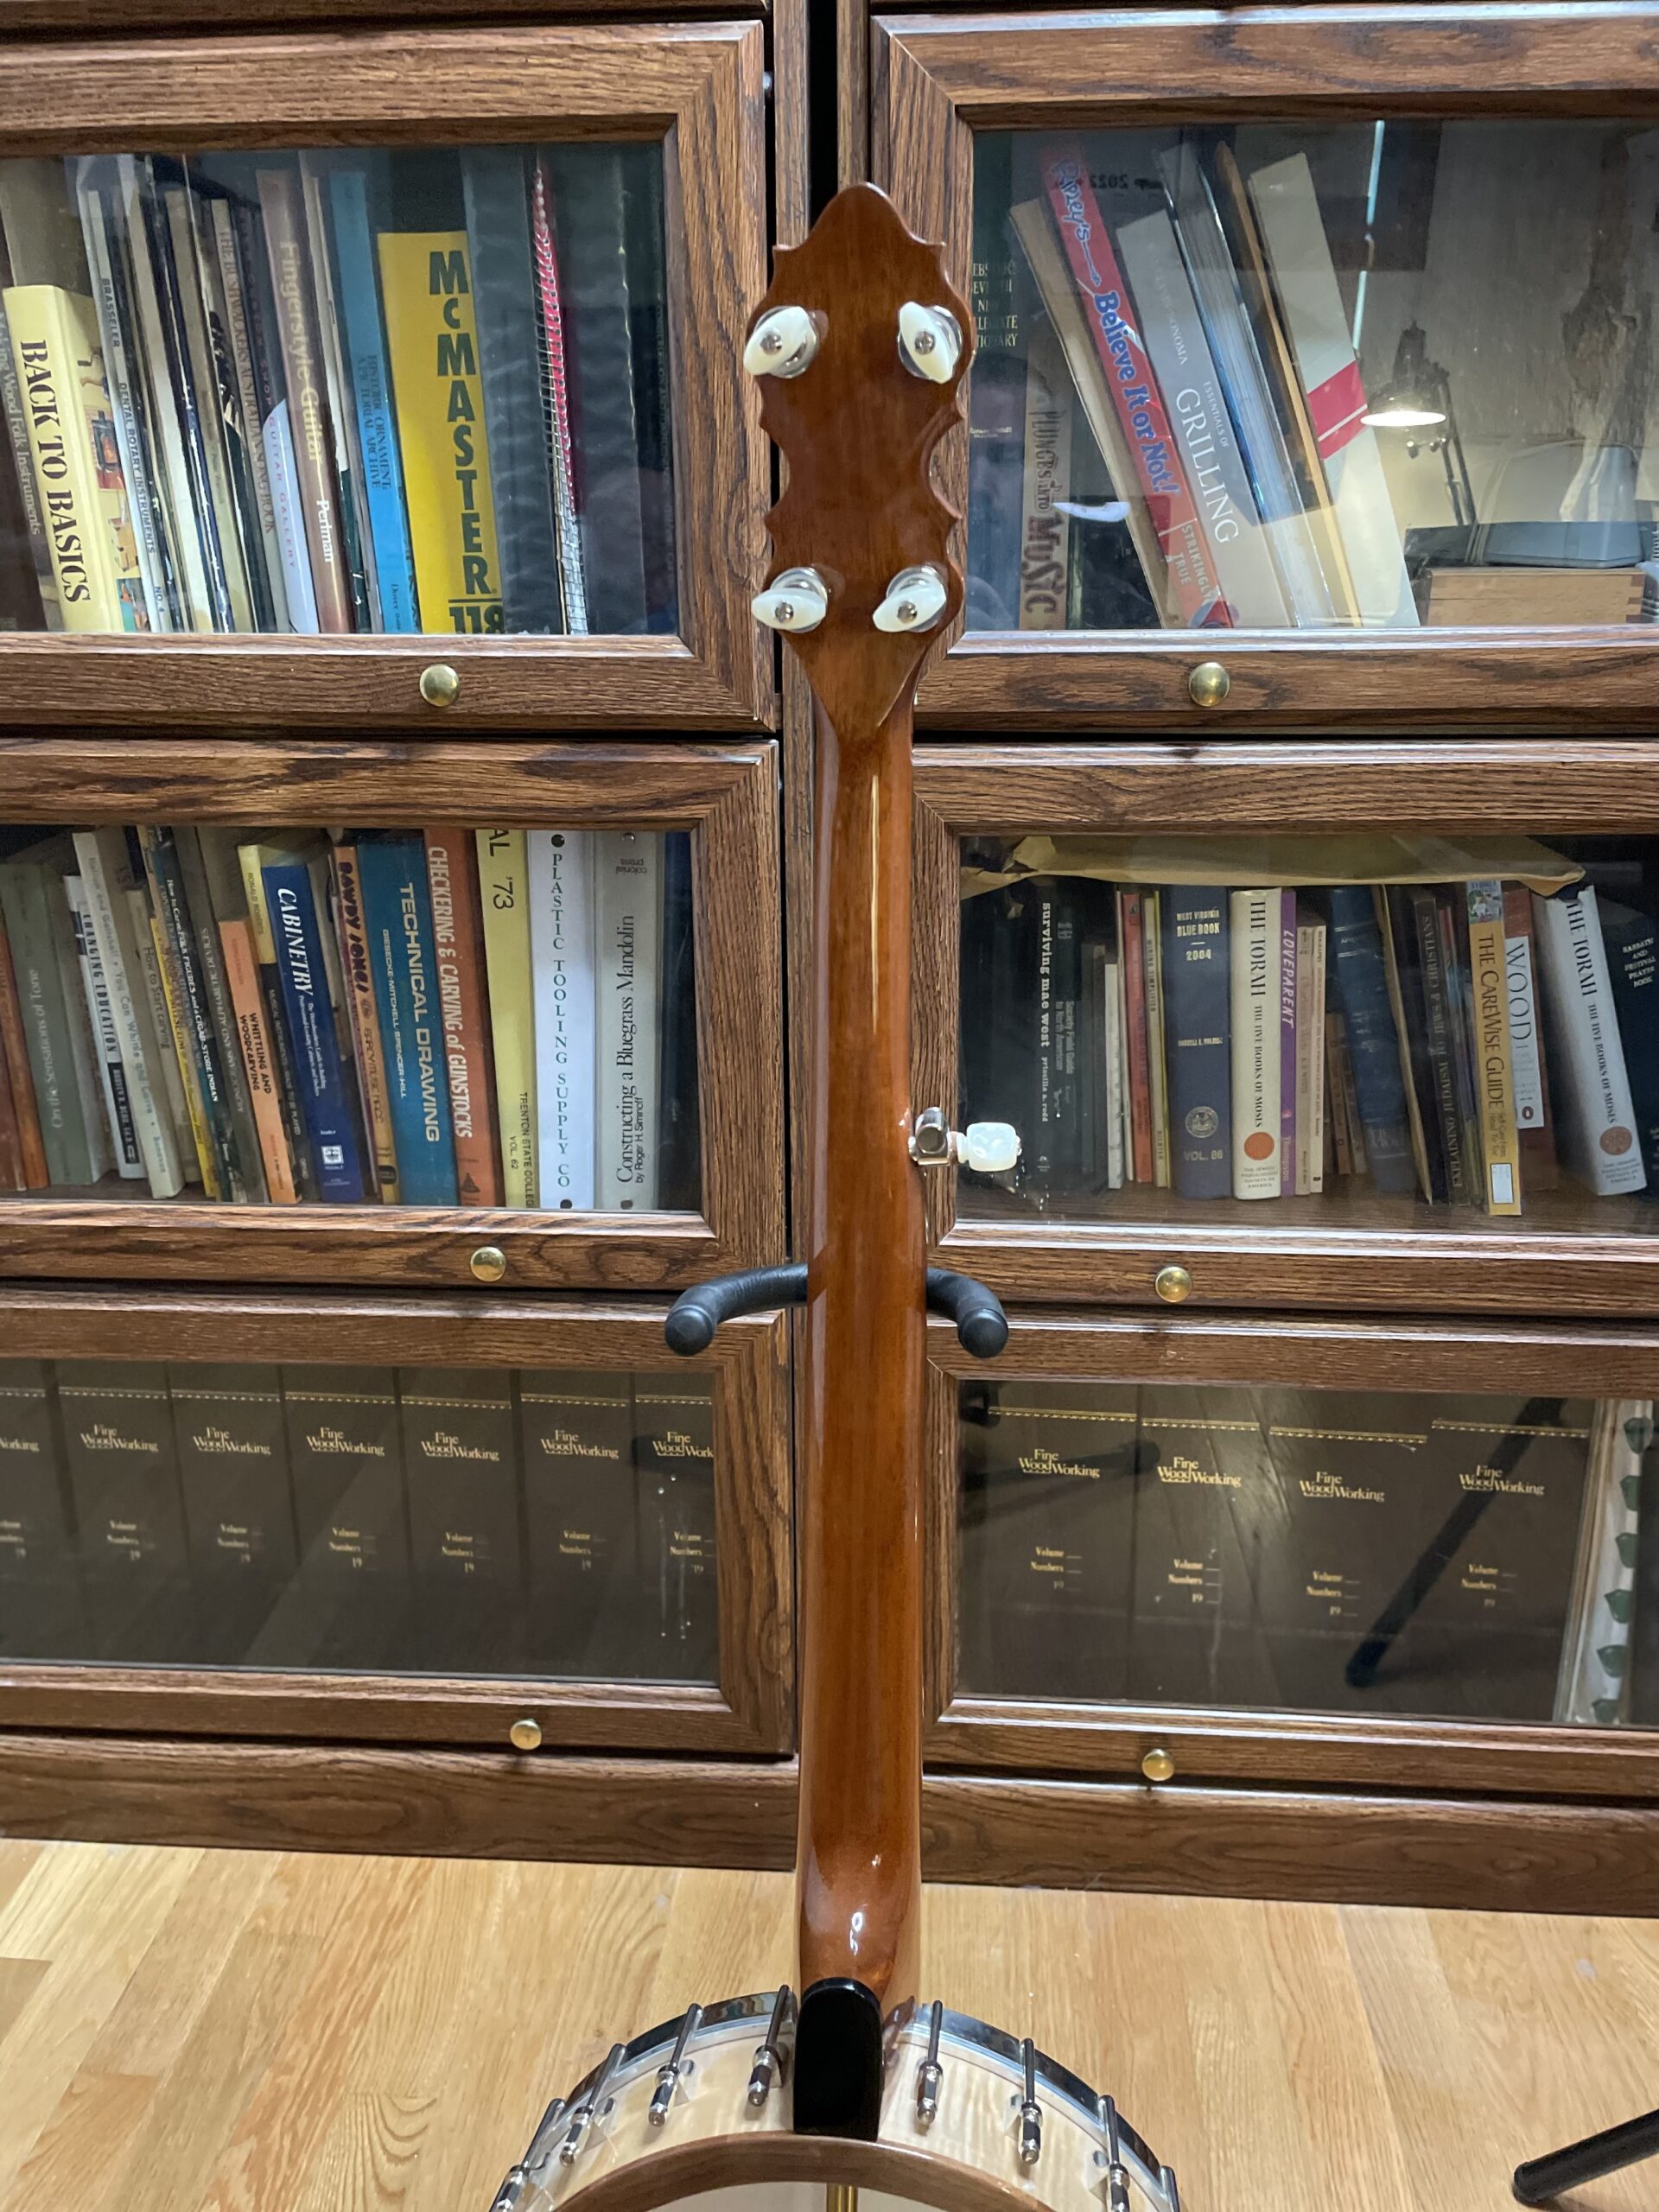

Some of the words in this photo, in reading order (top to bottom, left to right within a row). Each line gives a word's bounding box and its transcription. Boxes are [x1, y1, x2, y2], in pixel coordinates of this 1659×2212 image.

[101, 277, 120, 347] BRASSELER
[276, 238, 316, 381] Fingerstyle
[299, 385, 327, 464] Guitar
[1094, 290, 1136, 381] Believe
[5, 372, 22, 416] Wood
[20, 339, 61, 429] BACK
[1123, 385, 1151, 410] It
[1133, 411, 1155, 440] or
[1204, 381, 1225, 434] ESSENTIALS
[1219, 435, 1230, 448] OF
[10, 417, 29, 450] Folk
[38, 435, 68, 480] TO
[119, 382, 133, 422] DENTAL
[126, 424, 142, 474] ROTARY
[135, 476, 156, 554] INSTRUMENTS
[365, 436, 381, 488] ARCHIVE
[1141, 442, 1180, 495] Not!
[1176, 389, 1239, 543] GRILLING
[16, 451, 41, 535] Instruments
[266, 416, 284, 482] GUITAR
[277, 492, 296, 569] GALLERY
[47, 489, 91, 602] BASICS
[315, 498, 337, 562] Perlman
[1022, 514, 1066, 614] MUSIC
[1173, 552, 1192, 585] TRUE
[1181, 524, 1213, 606] STRIKINGLY
[449, 605, 505, 633] 118
[166, 879, 176, 897] How
[337, 860, 361, 931] BAWDY
[427, 845, 456, 943] CHECKERING
[493, 876, 514, 910] '73
[550, 853, 565, 950] PLASTIC
[172, 907, 183, 931] Carve
[1177, 924, 1196, 937] BLUE
[1198, 922, 1219, 935] BOOK
[1250, 900, 1265, 932] THE
[200, 926, 215, 968] DEVICES
[273, 886, 317, 998] CABINETRY
[439, 946, 455, 958] &
[617, 915, 634, 991] Mandolin
[1039, 902, 1052, 974] surviving
[1145, 939, 1154, 967] WIRING
[1421, 915, 1440, 988] CHRISTIANS
[1478, 933, 1495, 966] THE
[143, 946, 156, 970] How
[1185, 949, 1211, 961] 2004
[1250, 938, 1265, 995] TORAH
[1573, 938, 1598, 997] TORAH
[27, 967, 43, 1000] Tone
[80, 913, 103, 978] CHANGING
[94, 983, 118, 1052] EDUCATION
[114, 971, 127, 991] You
[148, 973, 159, 985] to
[181, 955, 196, 993] FIGURES
[1279, 929, 1296, 1028] LOVEPARENT
[119, 995, 132, 1017] Can
[150, 987, 165, 1011] Start
[190, 995, 200, 1009] and
[209, 971, 227, 1027] ALPHABETIC
[439, 963, 464, 1031] CARVING
[1040, 978, 1049, 1008] mae
[1506, 943, 1533, 1042] WOOD
[33, 1003, 46, 1016] of
[397, 881, 427, 1022] TECHNICAL
[414, 1027, 441, 1142] DRAWING
[553, 960, 568, 1065] TOOLING
[1065, 1001, 1074, 1029] Society
[1432, 1006, 1444, 1033] JEWS
[1586, 1003, 1599, 1020] THE
[155, 1012, 172, 1050] carving
[194, 1014, 213, 1072] CIGAR-STORE
[220, 1027, 232, 1048] AND
[447, 1033, 466, 1052] of
[617, 996, 637, 1065] Bluegrass
[1040, 1013, 1051, 1046] west
[1065, 1032, 1074, 1050] Field
[35, 1020, 56, 1084] Sensations
[238, 1014, 261, 1091] WOODCARVING
[248, 1012, 267, 1070] WHITTLING
[260, 1072, 272, 1094] AND
[1065, 1052, 1074, 1073] Guide
[1594, 1043, 1608, 1076] BOOKS
[206, 1072, 219, 1102] INDIAN
[621, 1071, 632, 1080] a
[1254, 1081, 1262, 1093] OF
[1439, 1061, 1453, 1111] JUDAISM
[1600, 1077, 1611, 1090] OF
[46, 1087, 60, 1107] the
[448, 1053, 474, 1139] GUNSTOCKS
[1603, 1092, 1617, 1123] MOSES
[49, 1108, 63, 1128] On
[518, 1092, 530, 1135] TRENTON
[556, 1073, 569, 1154] SUPPLY
[635, 1096, 644, 1132] Siminoff
[616, 1085, 636, 1182] Constructing
[634, 1133, 642, 1141] H.
[512, 1160, 518, 1170] 62
[521, 1138, 531, 1166] STATE
[634, 1145, 644, 1170] Roger
[1281, 1135, 1291, 1180] Thompson
[1445, 1116, 1462, 1186] EXPLAINING
[524, 1169, 535, 1209] COLLEG
[557, 1164, 570, 1187] CO
[634, 1173, 644, 1183] by
[80, 1433, 159, 1452] WoodWorking
[93, 1424, 117, 1437] Fine
[193, 1435, 271, 1455] WoodWorking
[207, 1427, 229, 1440] Fine
[306, 1435, 385, 1457] WoodWorking
[320, 1427, 344, 1440] Fine
[435, 1432, 459, 1444] Fine
[555, 1429, 578, 1442] Fine
[666, 1432, 690, 1444] Fine
[421, 1440, 499, 1461] WoodWorking
[540, 1439, 620, 1460] WoodWorking
[652, 1440, 714, 1458] WoodWork
[1034, 1449, 1058, 1462] Fine
[1173, 1457, 1198, 1470] Fine
[1019, 1458, 1100, 1478] WoodWorking
[1157, 1465, 1242, 1487] WoodWorking
[1316, 1471, 1342, 1484] Fine
[1476, 1465, 1503, 1478] Fine
[1300, 1480, 1385, 1502] WoodWorking
[1459, 1474, 1544, 1496] WoodWorking
